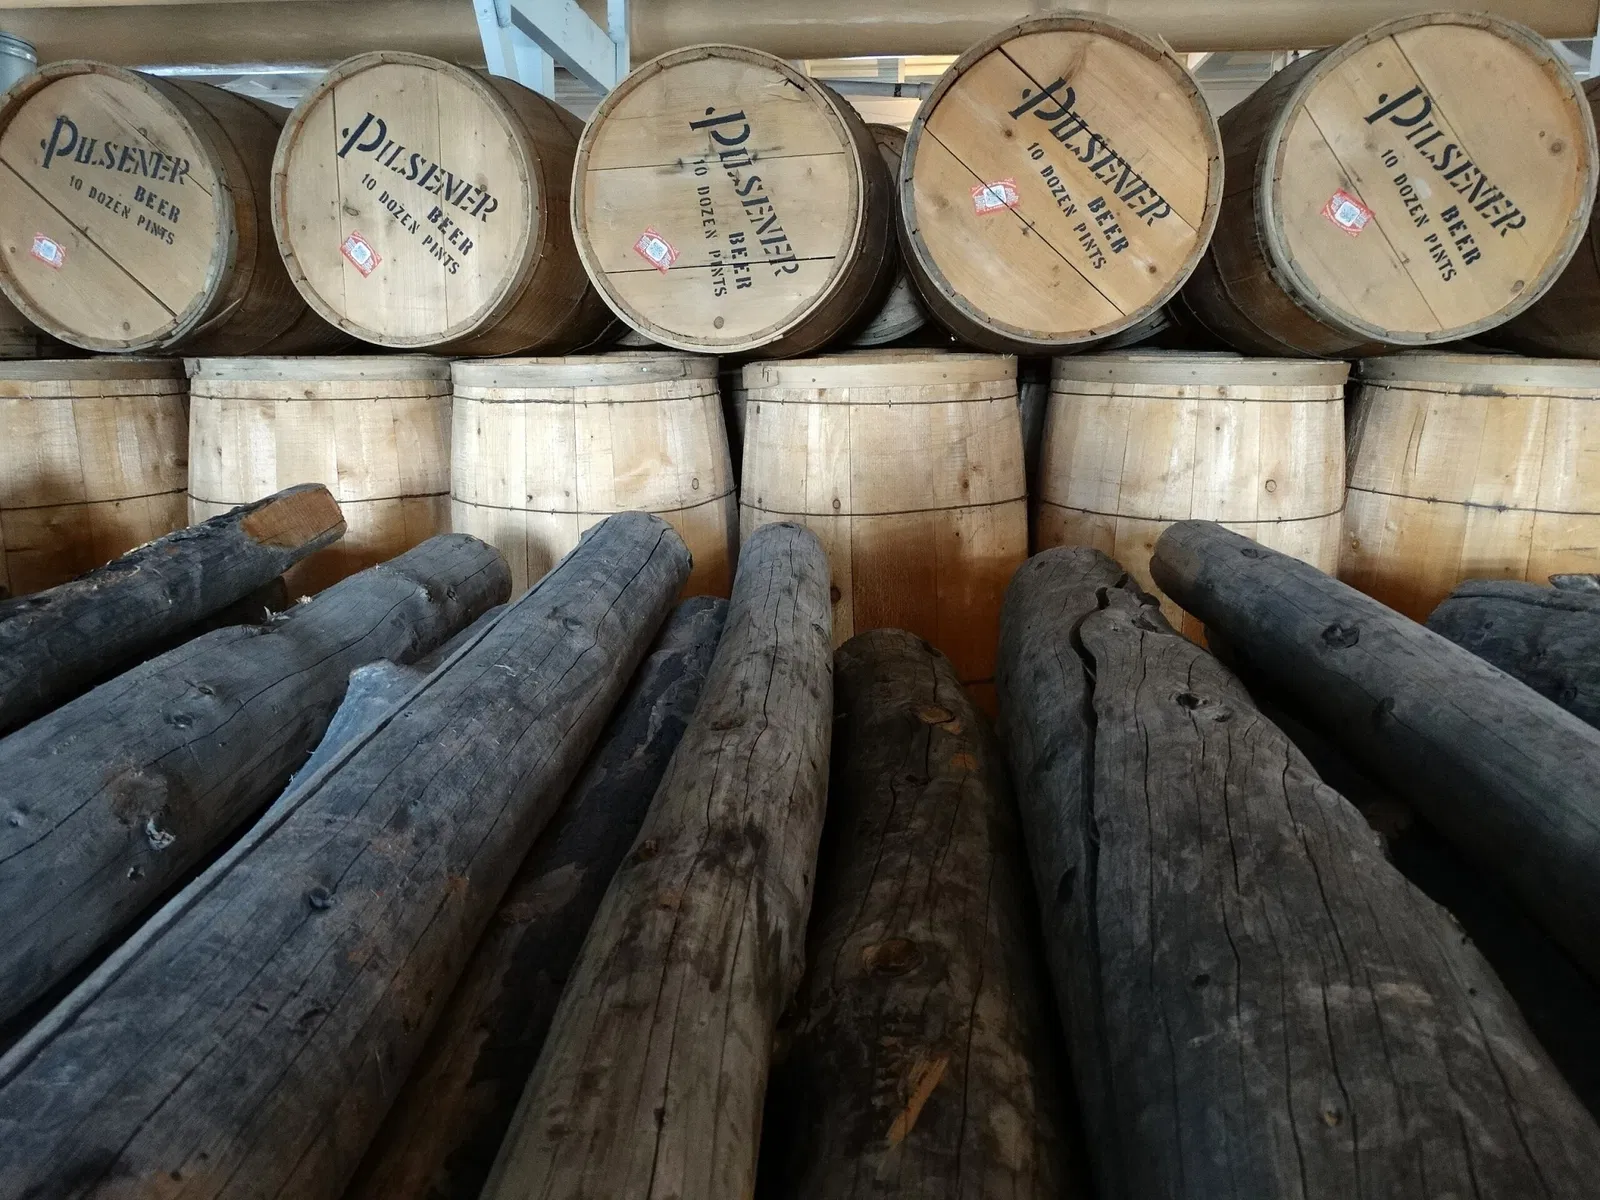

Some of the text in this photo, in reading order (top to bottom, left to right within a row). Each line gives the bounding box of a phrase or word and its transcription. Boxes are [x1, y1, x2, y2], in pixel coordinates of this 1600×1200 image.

[40, 115, 190, 185] PILSENER
[337, 112, 498, 223] PILSENER
[688, 106, 799, 277] PILSENER
[1008, 76, 1171, 227] PILSENER
[1363, 84, 1527, 238] PILSENER
[69, 174, 175, 246] 10 DOZEN PINTS
[134, 185, 181, 224] BEER
[361, 173, 377, 191] 10
[378, 190, 421, 235] DOZEN
[422, 234, 460, 275] PINTS
[426, 205, 474, 256] BEER
[693, 159, 728, 297] 10 DOZEN PINTS
[1027, 142, 1107, 270] 10 DOZEN PINTS
[1087, 195, 1130, 254] BEER
[1380, 148, 1457, 282] 10 DOZEN PINTS
[1440, 205, 1482, 266] BEER
[728, 231, 752, 290] BEER
